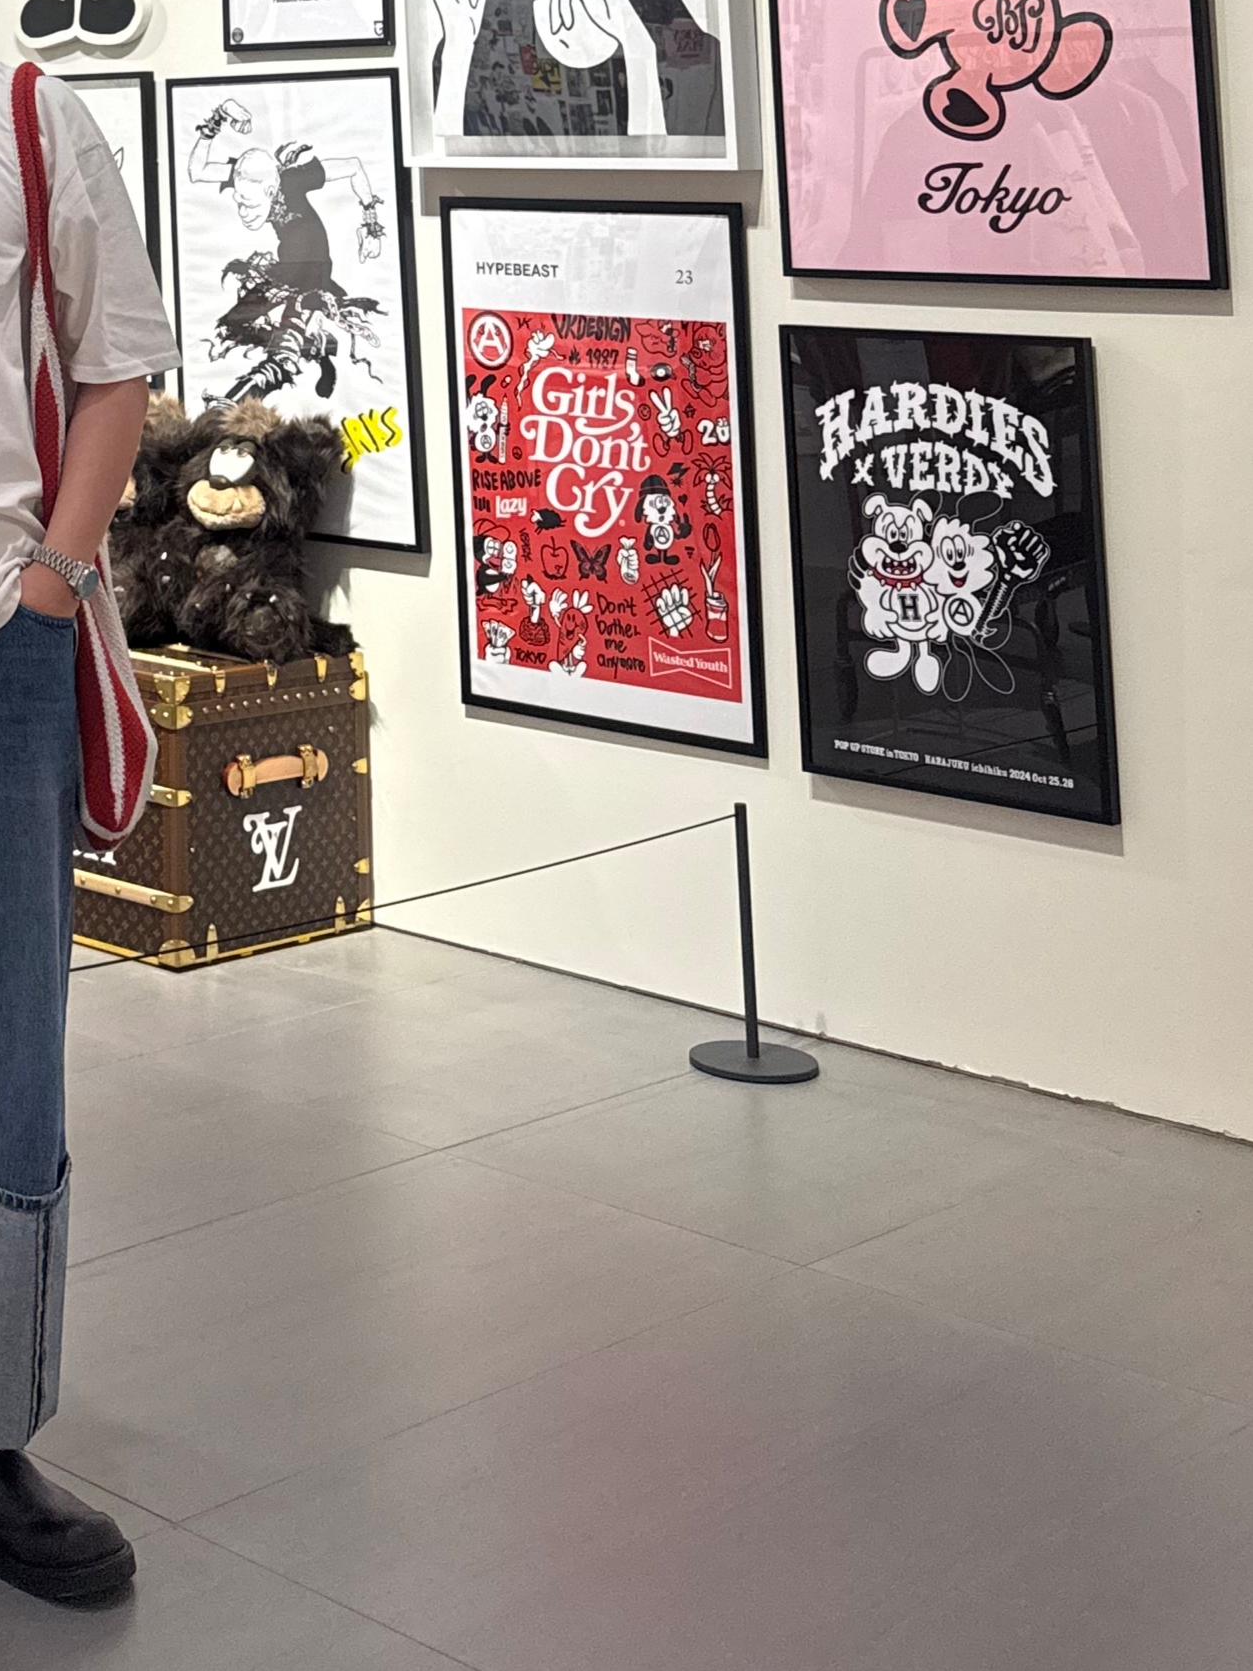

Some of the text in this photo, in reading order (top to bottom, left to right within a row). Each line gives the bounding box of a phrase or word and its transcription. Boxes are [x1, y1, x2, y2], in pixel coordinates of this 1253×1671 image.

[917, 163, 1072, 234] Tokyo
[476, 262, 693, 285] HYPEBEAST 23
[551, 313, 632, 343] VKDESIGN
[585, 348, 619, 369] 1987
[531, 366, 636, 434] Girls
[520, 414, 651, 473] Don't
[815, 380, 1057, 498] HARDIES
[473, 469, 541, 491] RISE ABOVE
[881, 438, 1014, 499] VERDY
[496, 495, 527, 518] Lazy
[545, 463, 633, 537] Cry
[597, 593, 637, 616] Don't
[897, 594, 921, 622] H
[514, 647, 546, 663] TOKYO
[604, 636, 627, 653] me
[653, 651, 728, 674] Wasted Youth
[834, 739, 849, 750] POP
[850, 742, 861, 753] UP
[861, 744, 885, 758] STORE
[894, 749, 919, 763] TOKYO
[1009, 769, 1031, 781] 2024
[1032, 773, 1047, 785] Oct
